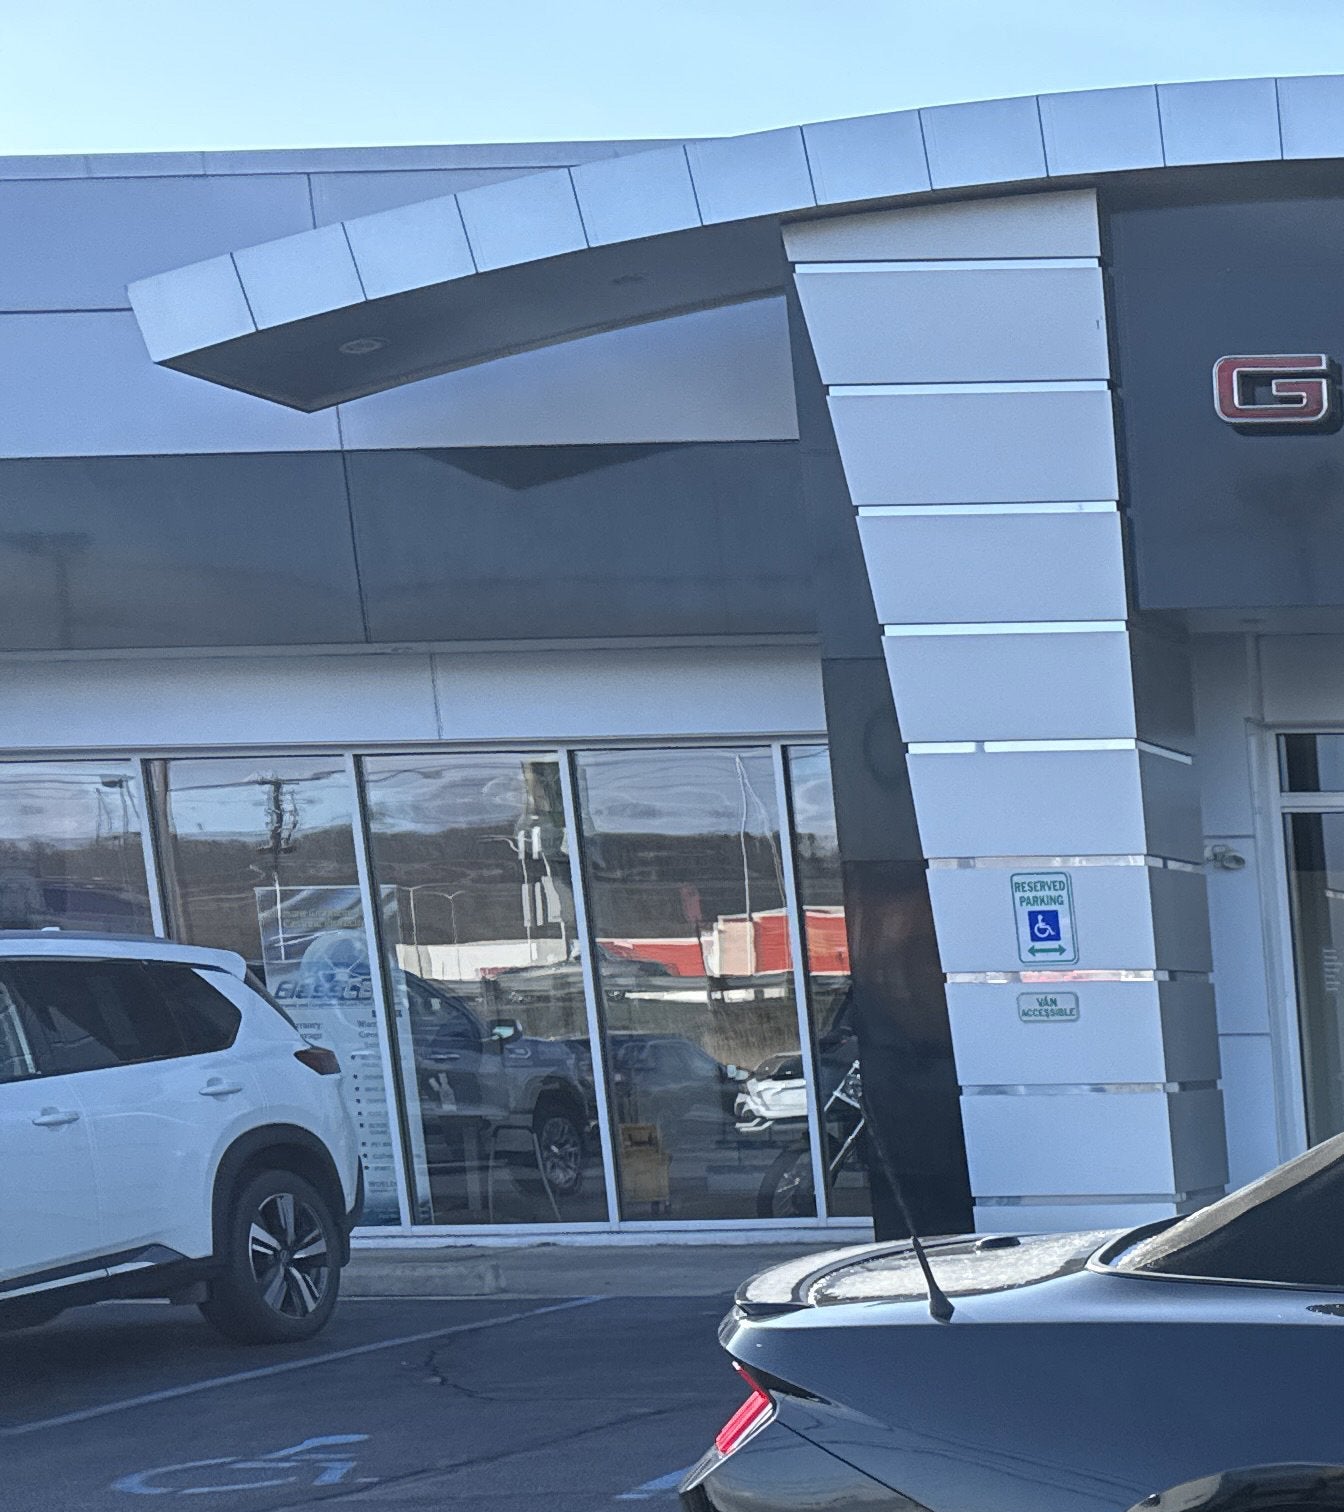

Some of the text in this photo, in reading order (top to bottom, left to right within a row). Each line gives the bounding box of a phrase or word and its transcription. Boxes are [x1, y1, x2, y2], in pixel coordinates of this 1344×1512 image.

[1014, 880, 1066, 893] RESERVED
[1019, 894, 1064, 907] PARKING
[1036, 997, 1058, 1007] VAN
[1021, 1007, 1076, 1018] ACCESSIBLE
